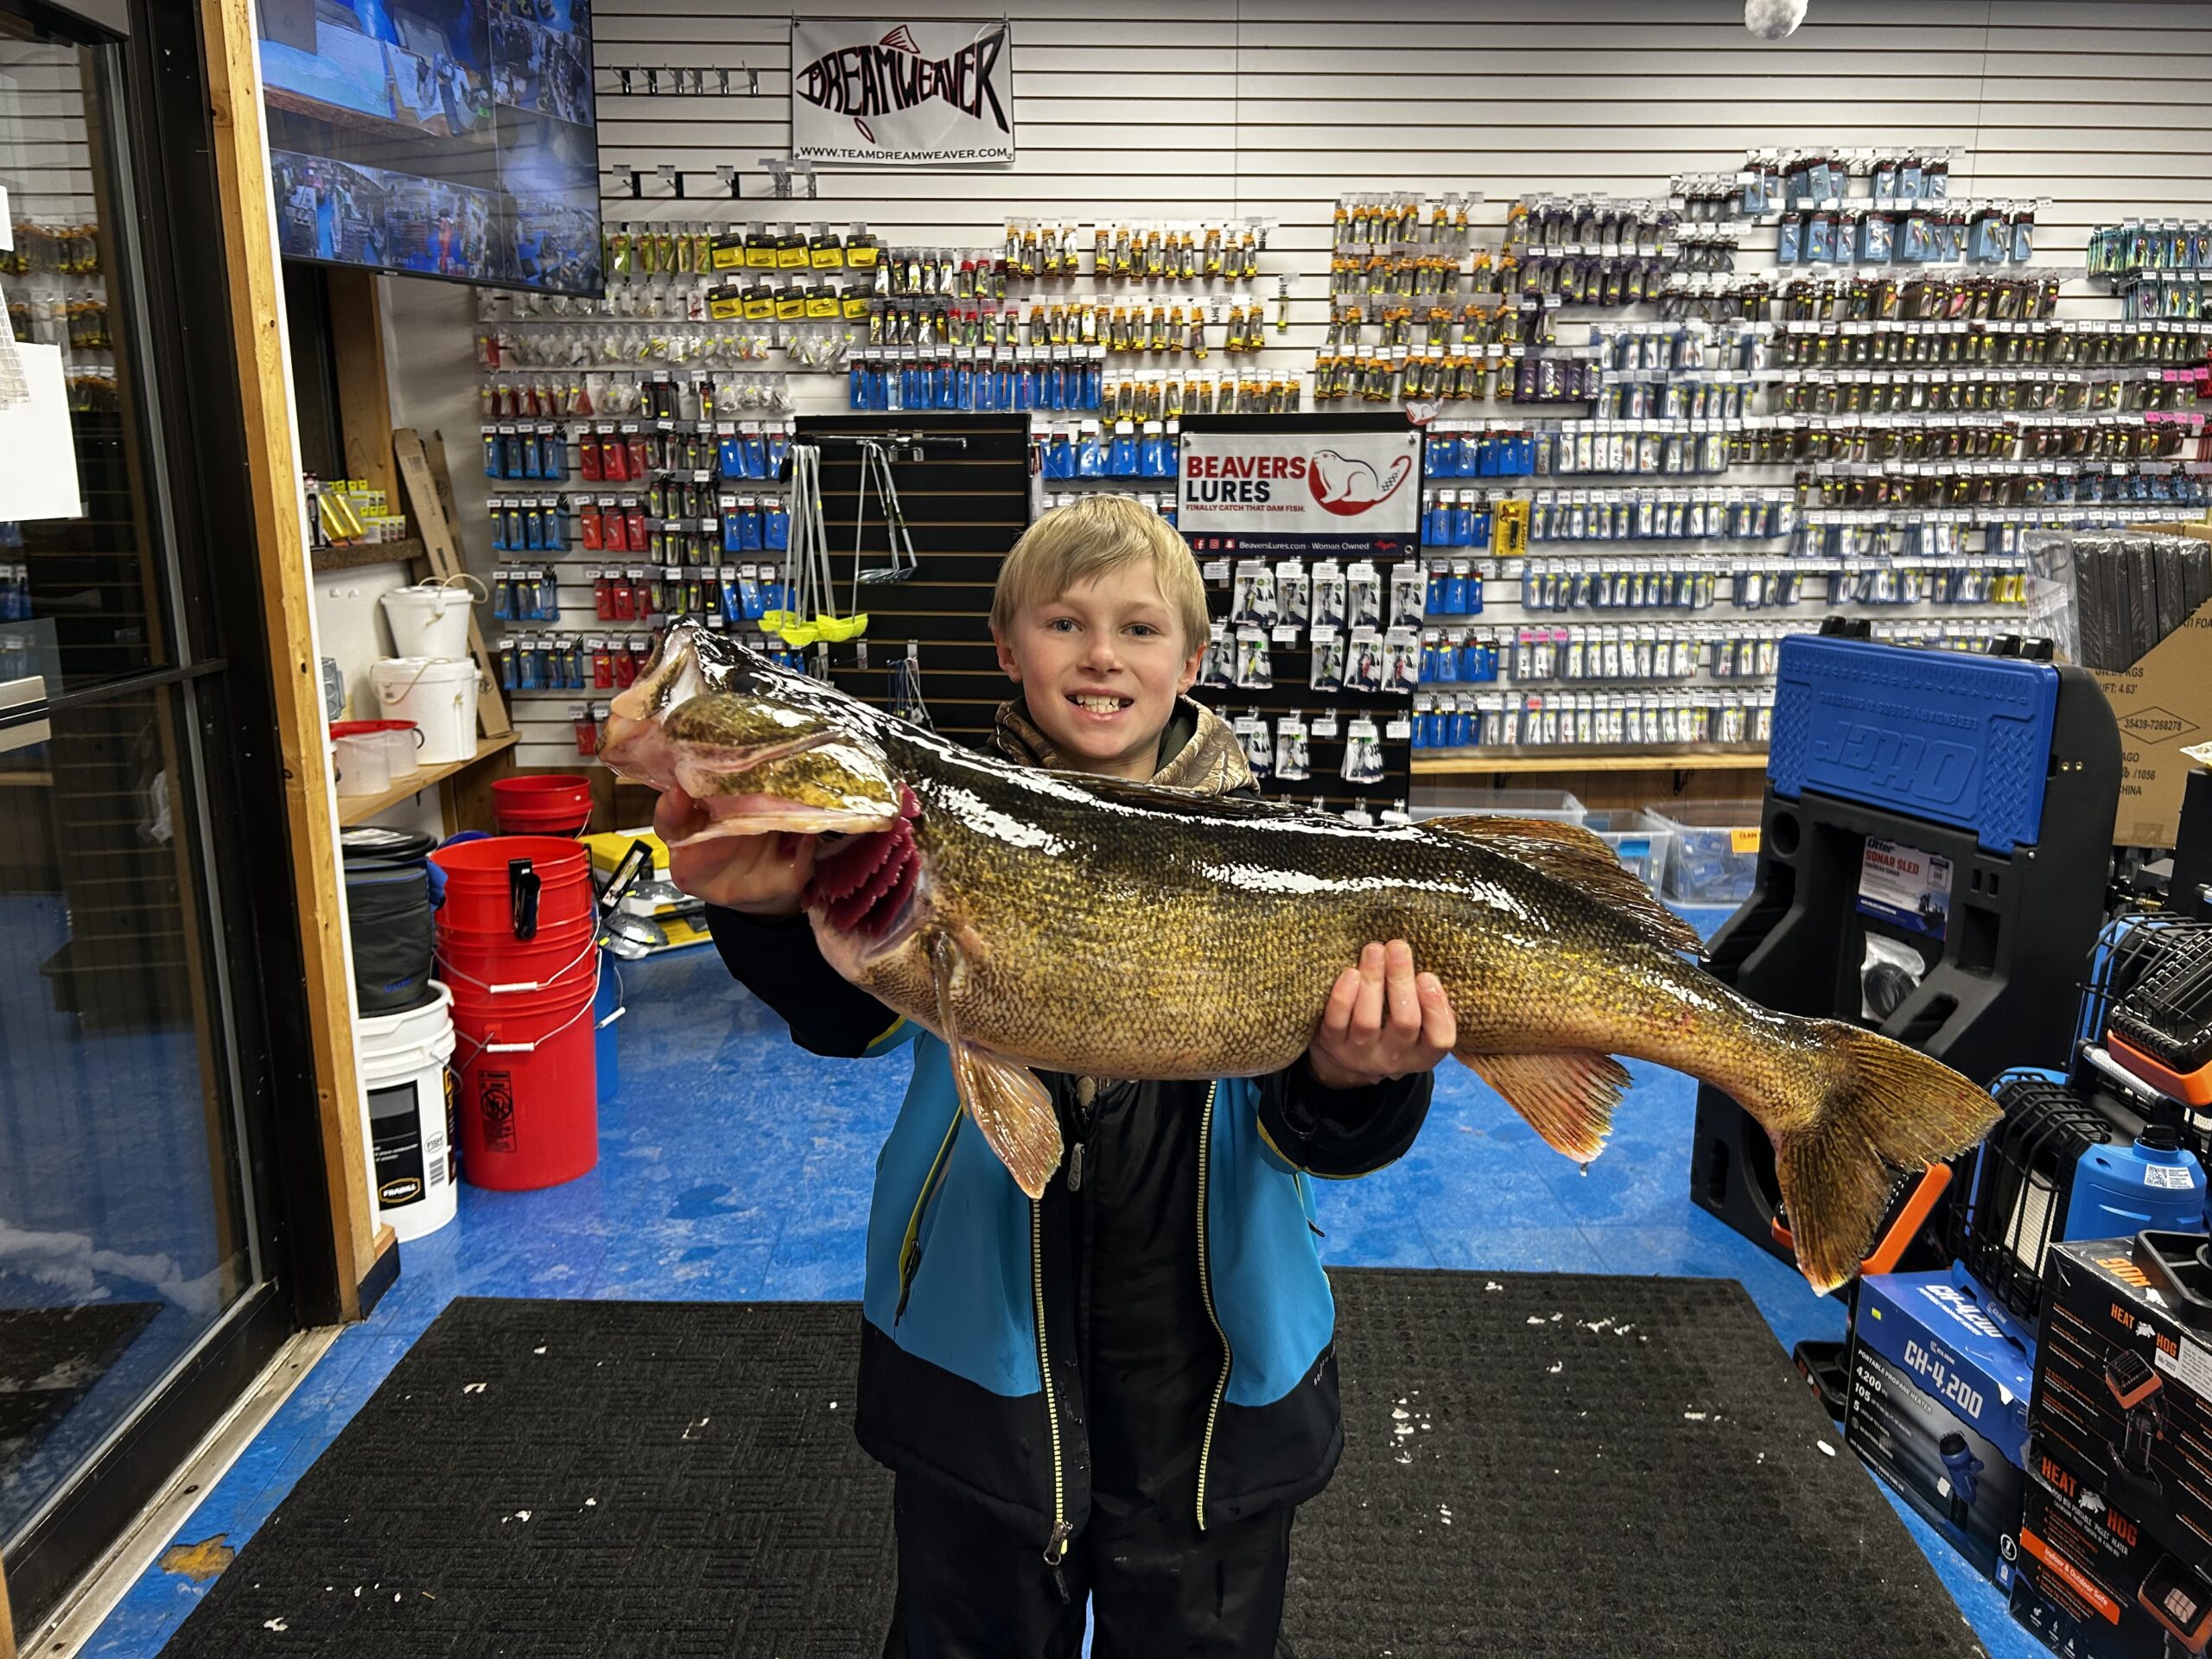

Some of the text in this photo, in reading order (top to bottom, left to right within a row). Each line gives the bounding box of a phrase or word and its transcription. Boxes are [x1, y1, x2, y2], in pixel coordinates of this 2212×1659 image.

[796, 29, 1009, 134] DREAMWEAVER
[800, 146, 1007, 160] WWW.TEAMDREAMWEAVER.COM
[1186, 455, 1306, 480] BEAVERS
[1185, 480, 1270, 503] LURES
[1239, 541, 1306, 550] BeaversLures.com
[1341, 542, 1370, 550] Owned
[2124, 718, 2182, 731] 35439-7268278
[1815, 720, 1978, 805] Otter
[2120, 785, 2141, 796] HINA
[1866, 850, 1896, 868] SONAR
[1897, 858, 1919, 875] SLED
[2111, 1303, 2135, 1330] HEAT
[2156, 1332, 2177, 1357] HOG
[1856, 1366, 1882, 1392] 4,200
[1859, 1349, 1933, 1414] PORTABLE PROPANE HEATER
[1904, 1339, 1984, 1420] CH-4,200
[1855, 1382, 1871, 1402] 105
[1853, 1400, 1860, 1412] 5
[2042, 1455, 2077, 1498] HEAT
[2107, 1506, 2139, 1548] HOG
[2111, 1537, 2128, 1556] HEATER
[2044, 1548, 2064, 1567] Indoor
[2069, 1569, 2094, 1593] Outdoor
[2094, 1589, 2108, 1606] Safe
